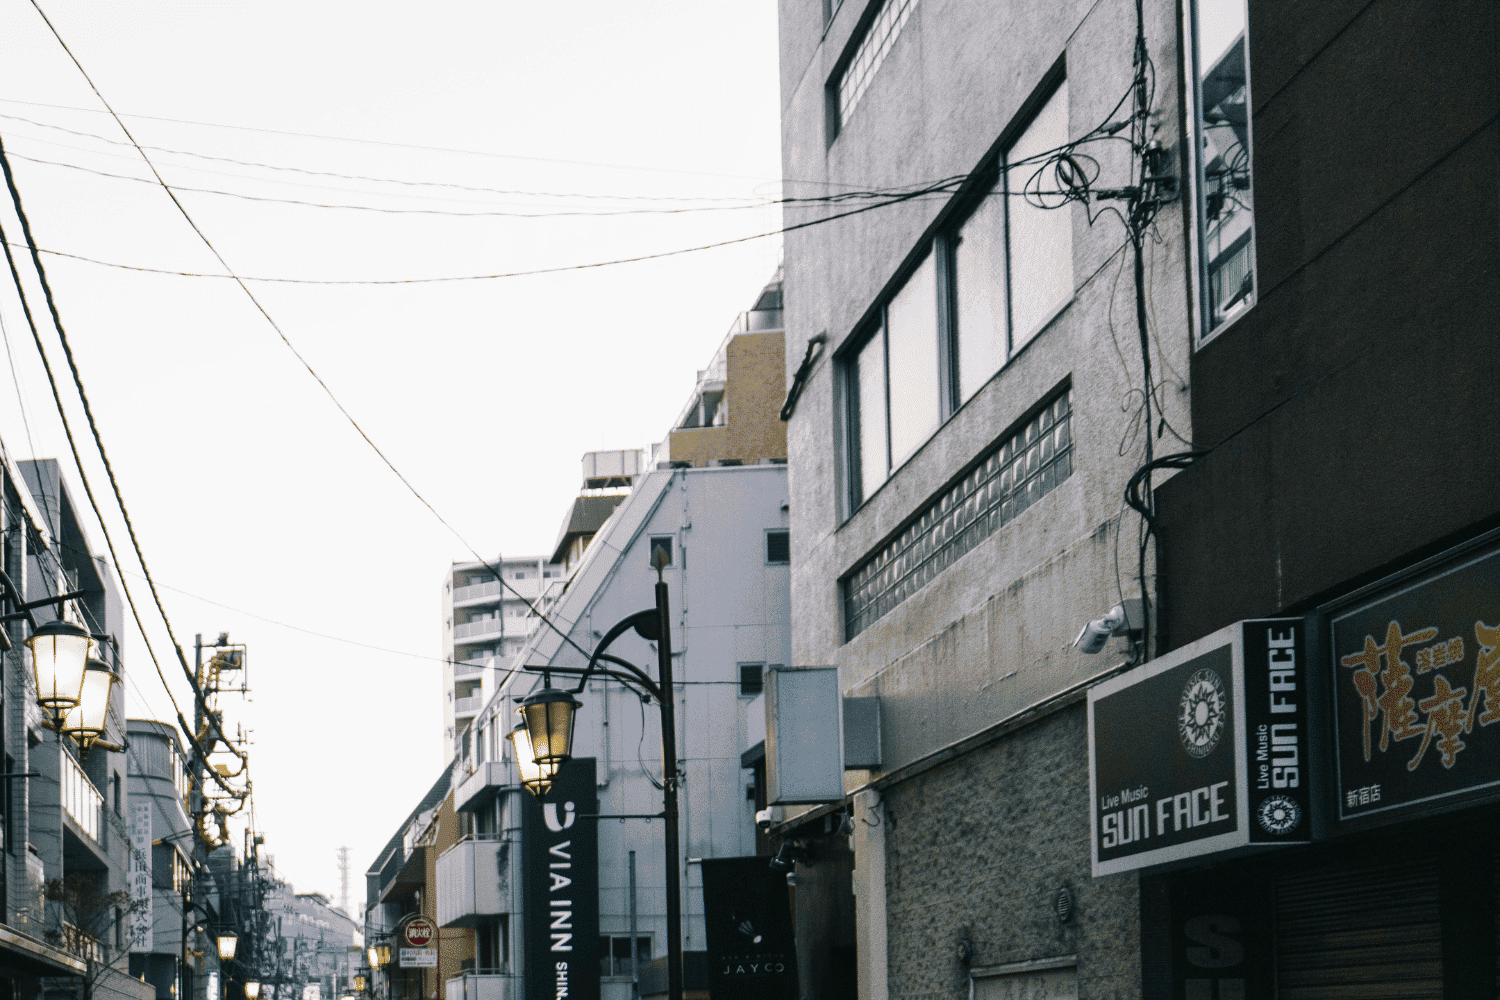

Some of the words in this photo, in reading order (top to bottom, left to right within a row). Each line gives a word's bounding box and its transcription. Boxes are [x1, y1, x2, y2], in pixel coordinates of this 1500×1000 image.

[1268, 627, 1297, 714] FACE
[1255, 724, 1269, 762] Music
[1270, 723, 1299, 789] SUN
[1101, 794, 1120, 811] Live
[1121, 784, 1149, 805] Music
[1257, 763, 1269, 789] Live
[1346, 784, 1382, 808] 新宿店
[1102, 803, 1150, 849] SUN
[1156, 780, 1230, 836] FACE
[549, 840, 572, 892] VIA
[550, 900, 573, 951] INN
[723, 962, 785, 976] JAYCO
